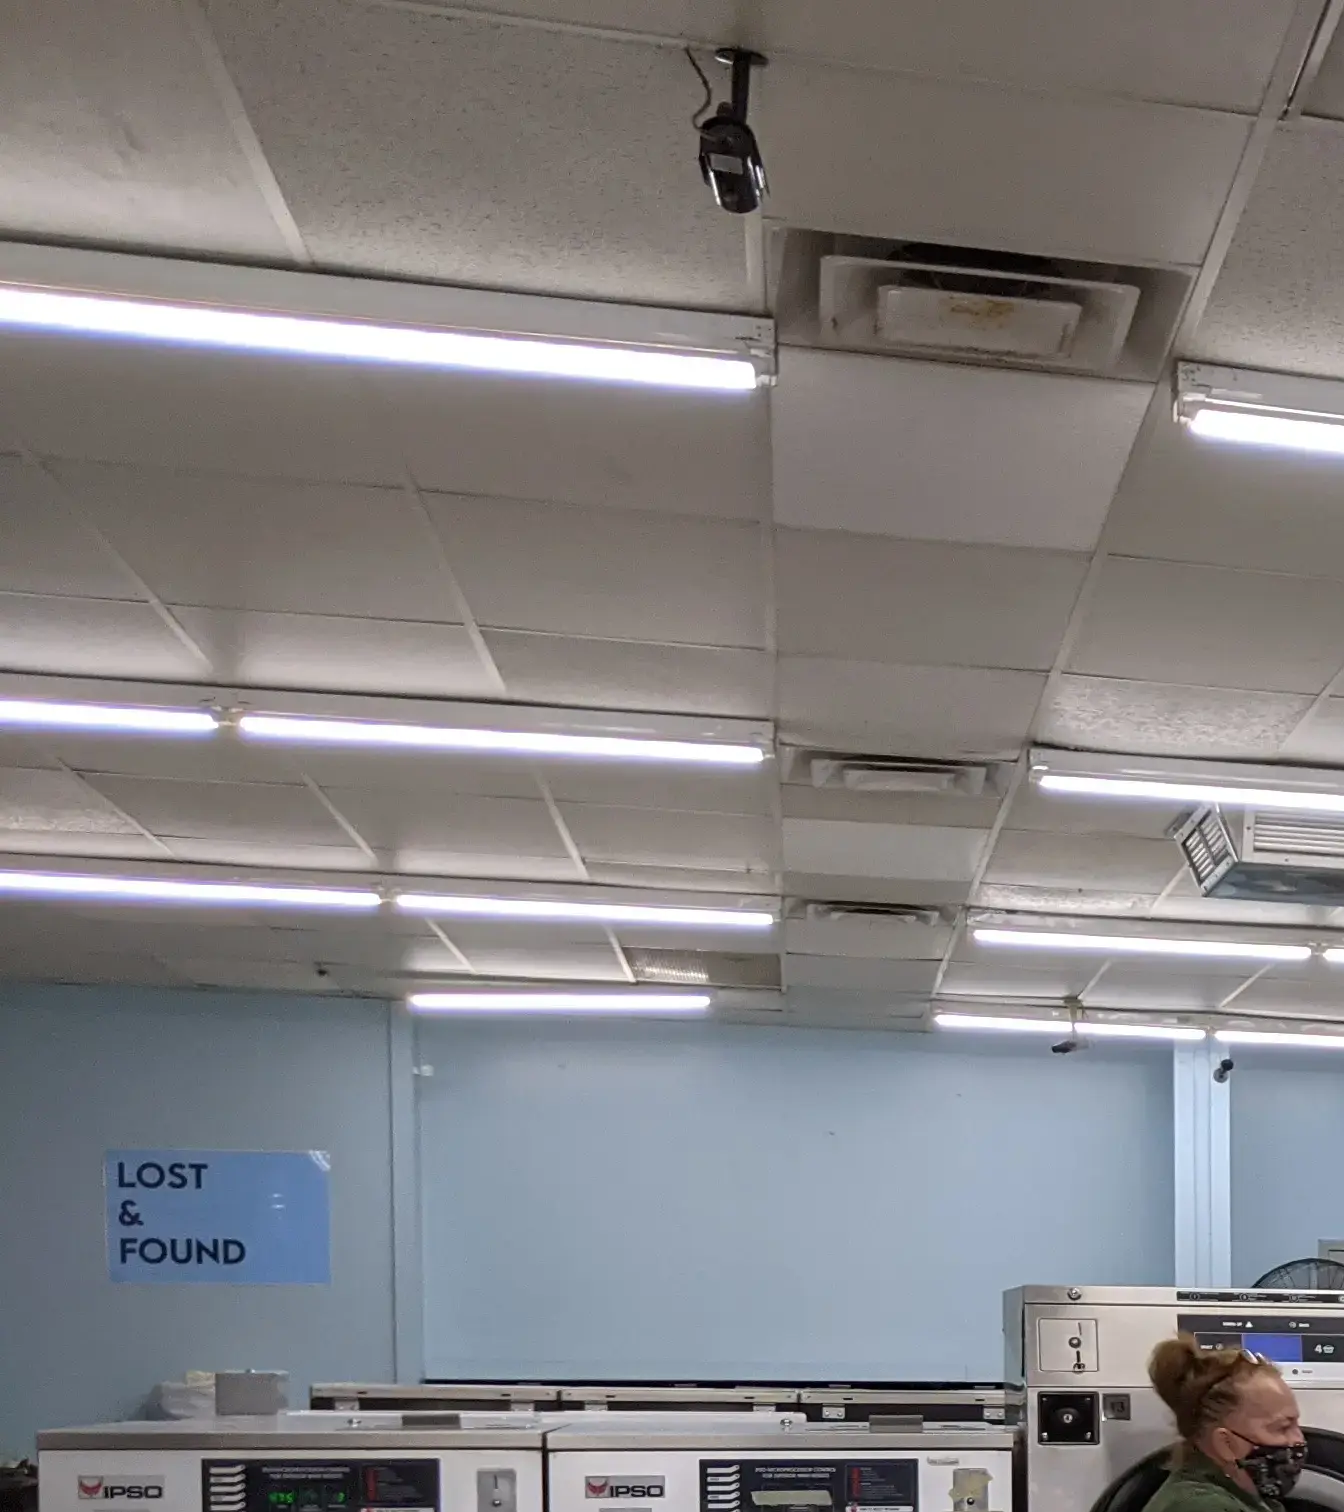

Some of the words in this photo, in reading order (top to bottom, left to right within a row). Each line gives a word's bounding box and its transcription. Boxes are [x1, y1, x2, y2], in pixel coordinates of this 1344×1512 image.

[117, 1161, 209, 1190] LOST
[118, 1199, 145, 1227] &
[119, 1237, 247, 1266] FOUND
[1314, 1344, 1323, 1354] 4
[103, 1485, 164, 1499] IPSO
[609, 1485, 665, 1498] IPSO
